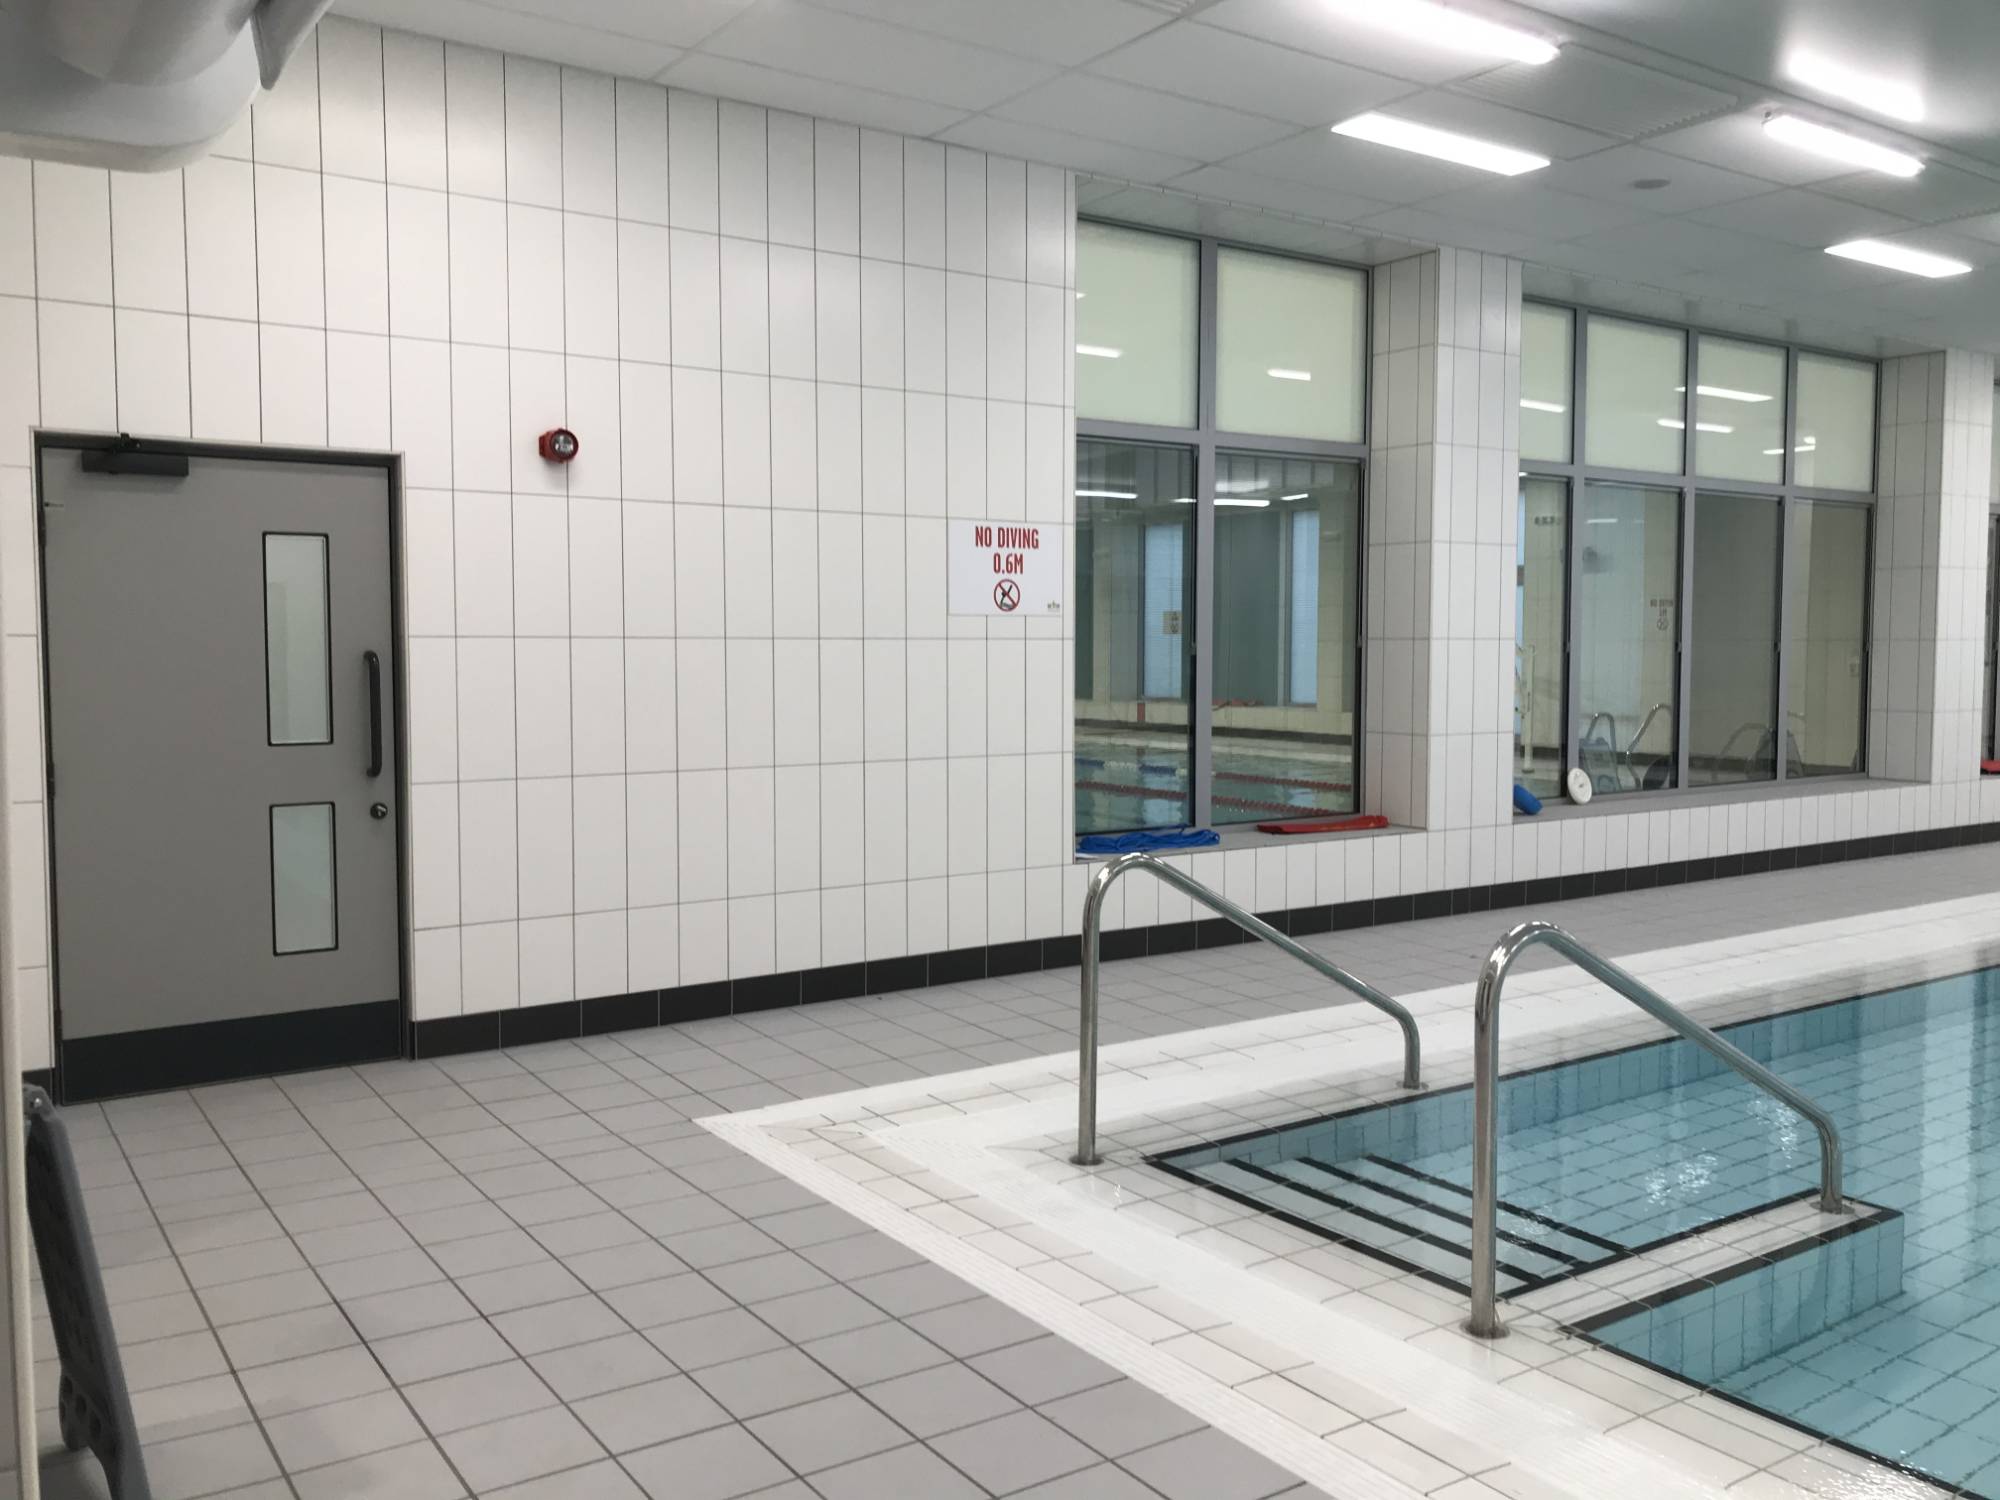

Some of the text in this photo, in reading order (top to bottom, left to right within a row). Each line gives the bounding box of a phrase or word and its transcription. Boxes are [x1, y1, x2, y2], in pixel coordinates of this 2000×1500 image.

[975, 526, 1039, 549] NO DIVING
[993, 552, 1024, 574] 0.6M
